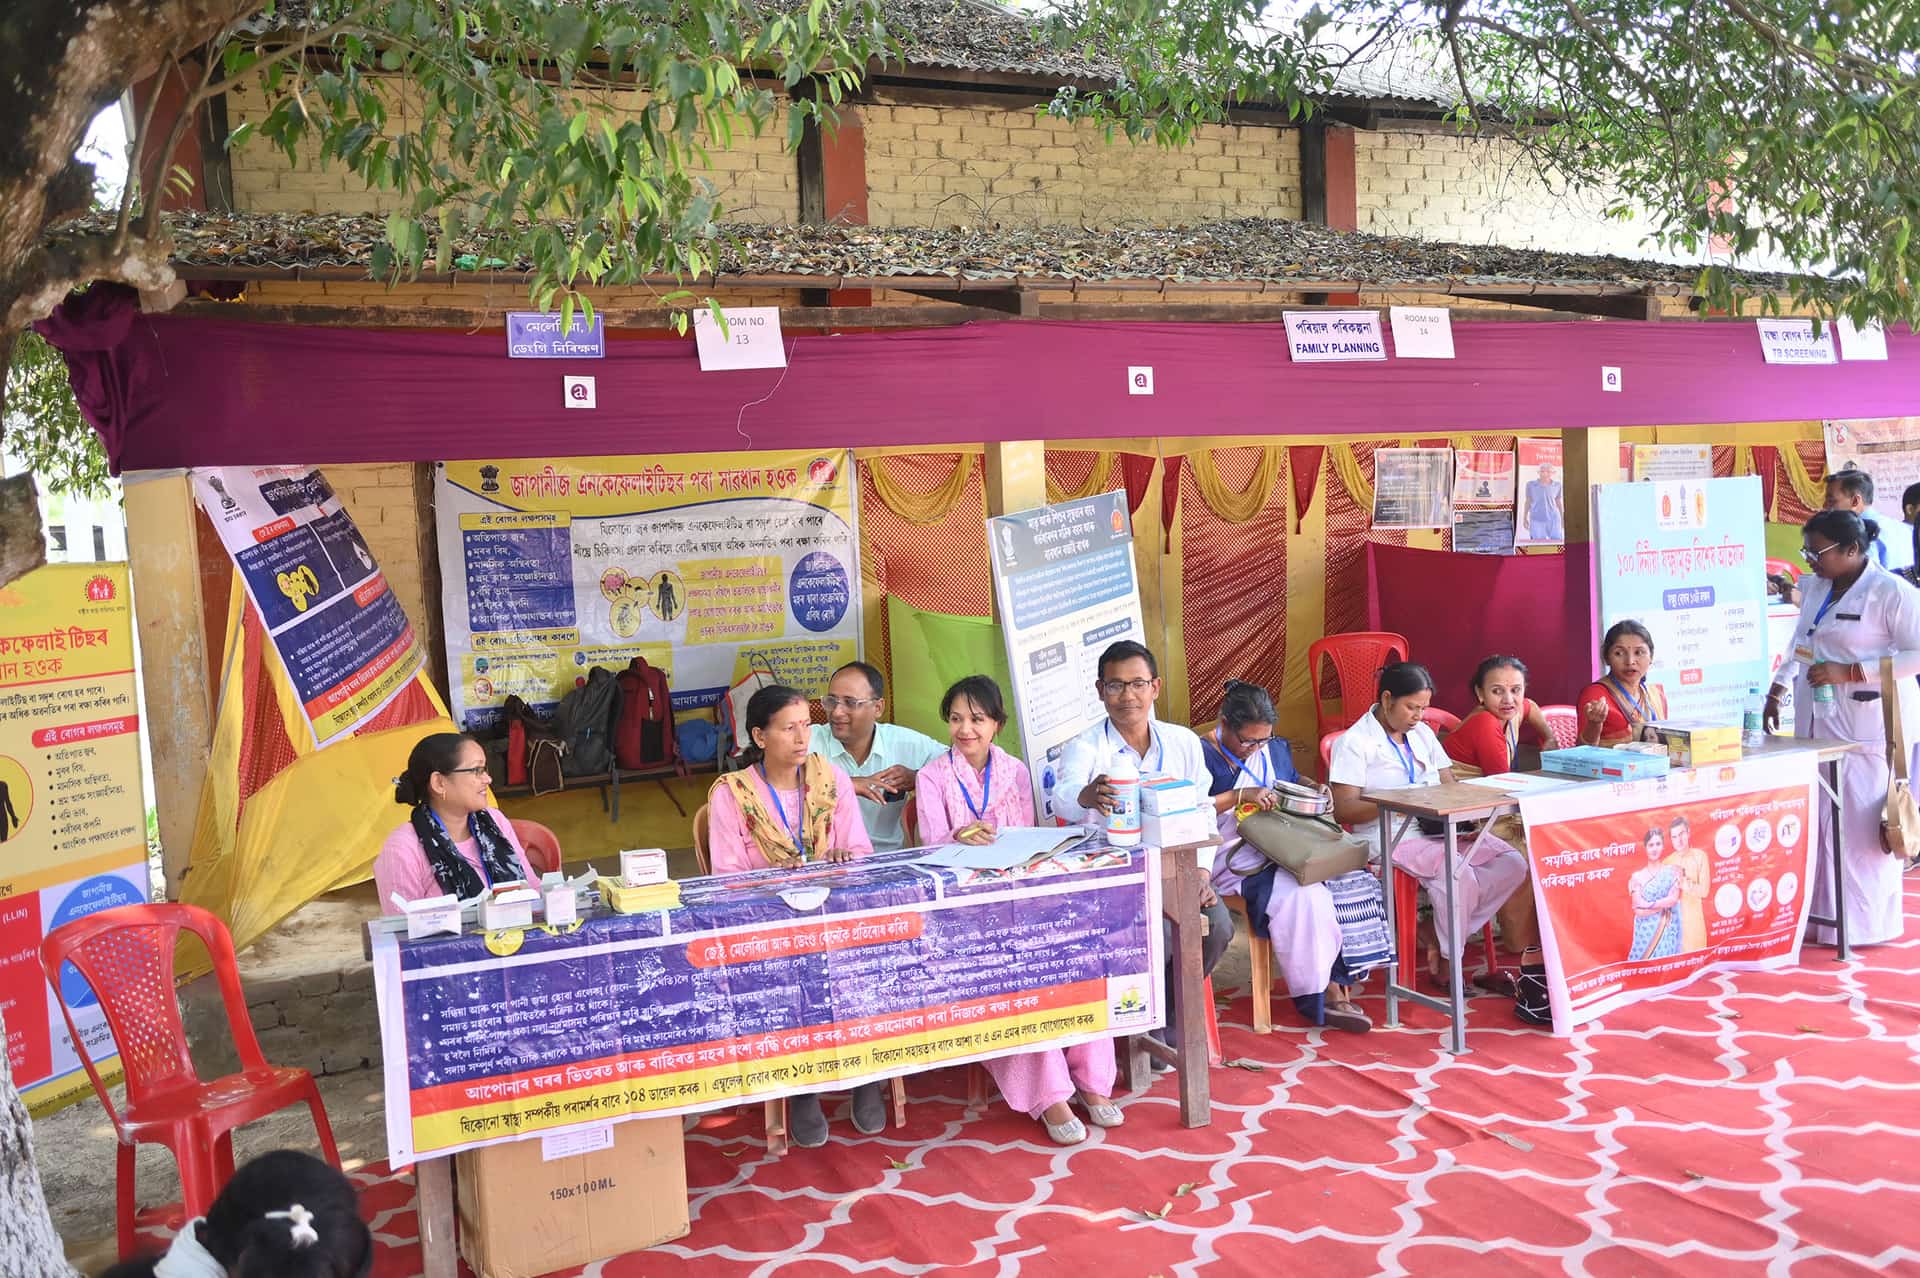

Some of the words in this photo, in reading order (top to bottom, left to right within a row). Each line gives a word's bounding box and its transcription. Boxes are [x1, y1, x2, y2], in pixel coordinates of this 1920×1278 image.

[713, 315, 747, 327] OM
[749, 317, 764, 326] NO
[1405, 314, 1427, 323] ROOM
[735, 334, 750, 345] 13
[1295, 342, 1329, 354] FAMILY
[1332, 342, 1380, 353] PLANNING
[1784, 348, 1827, 358] SCREENING
[510, 464, 570, 498] জাপানীজ
[690, 470, 713, 493] পৰা
[765, 468, 797, 490] হওক
[23, 657, 64, 677] হওক
[2, 908, 28, 924] (LLIN)
[464, 1078, 529, 1101] আপোনাৰ
[534, 1072, 562, 1091] ঘৰৰ
[566, 1064, 613, 1086] ভিতৰত
[615, 1059, 646, 1075] আৰু
[649, 1050, 695, 1071] বাহিৰত
[926, 1010, 948, 1025] পৰা
[950, 1003, 987, 1022] নিজকে
[989, 1000, 1011, 1014] ৰক্ষা
[1013, 995, 1040, 1010] কৰক
[460, 1114, 499, 1135] যিকোনো
[601, 1092, 621, 1108] বাবে
[624, 1087, 646, 1105] ১০৪
[678, 1081, 700, 1096] কৰক
[772, 1067, 789, 1081] বাবে
[792, 1062, 814, 1079] ১০৮
[842, 1055, 862, 1069] কৰক
[872, 1046, 903, 1064] যিকোনো
[1077, 1013, 1095, 1026] কৰক
[549, 1178, 616, 1202] 150x100ML
